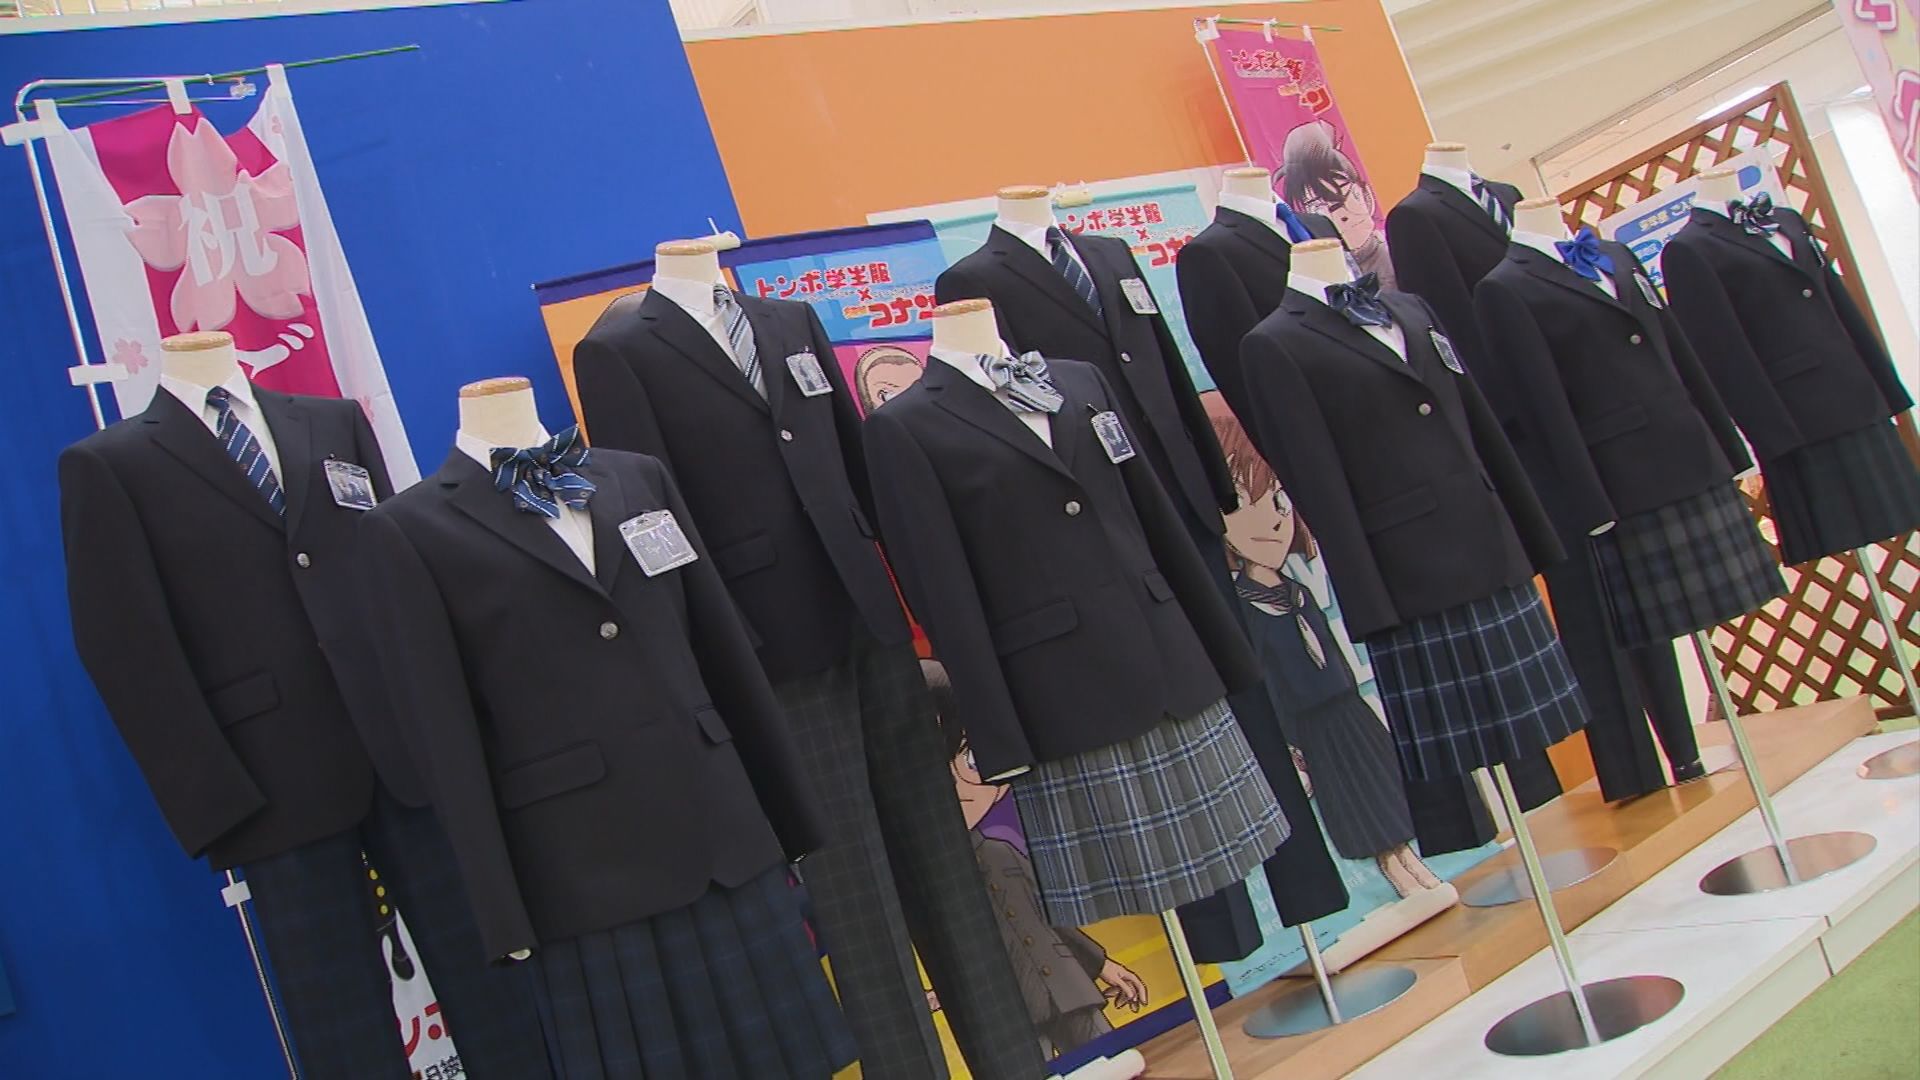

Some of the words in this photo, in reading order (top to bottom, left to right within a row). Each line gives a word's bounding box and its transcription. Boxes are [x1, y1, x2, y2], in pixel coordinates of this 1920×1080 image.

[1058, 202, 1163, 236] ンボ学生服
[756, 262, 892, 300] トンボ学生服
